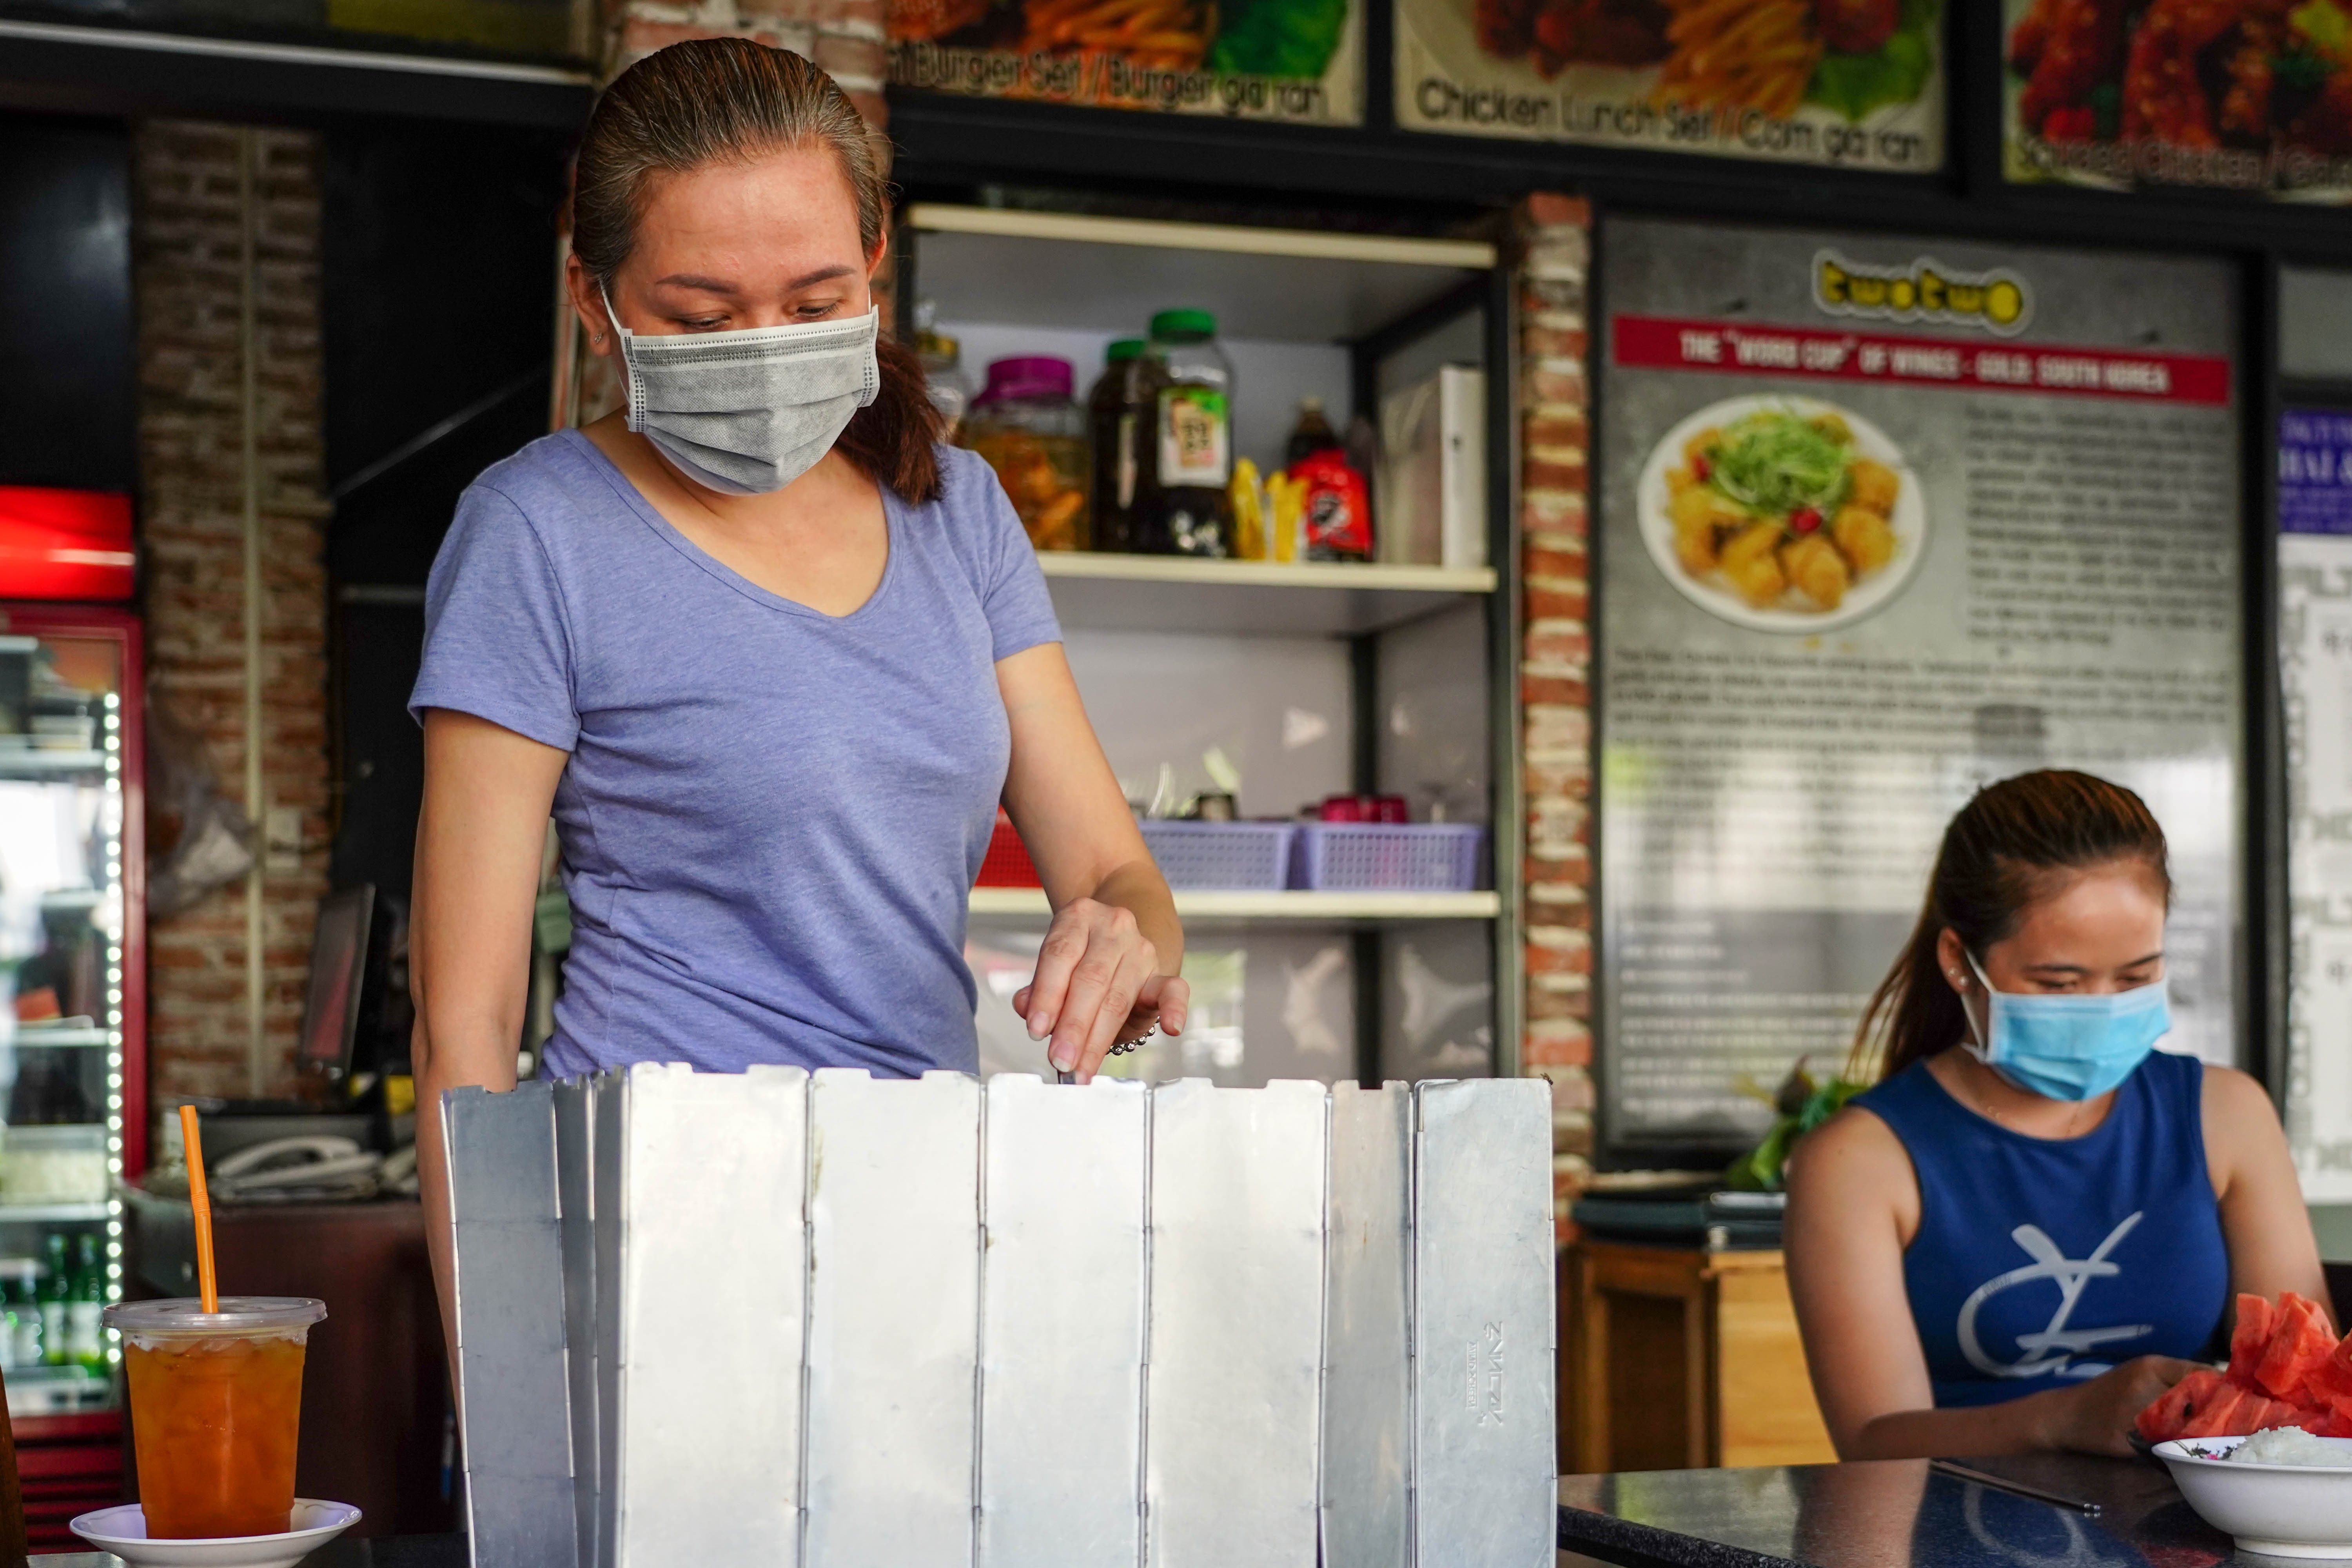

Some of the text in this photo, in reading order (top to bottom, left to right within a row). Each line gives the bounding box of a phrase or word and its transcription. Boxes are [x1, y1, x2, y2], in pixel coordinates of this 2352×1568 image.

[909, 42, 1022, 96] Burger
[1107, 58, 1213, 112] Burger
[1416, 78, 1552, 126] Chicken
[1560, 93, 1654, 136] Lunch
[1819, 257, 2024, 326] twotwo
[1680, 329, 1722, 364] THE
[1858, 343, 1888, 375] OF
[1891, 346, 1962, 379] WINGS
[2037, 354, 2100, 388] SOUTH
[2103, 358, 2172, 394] KOREA
